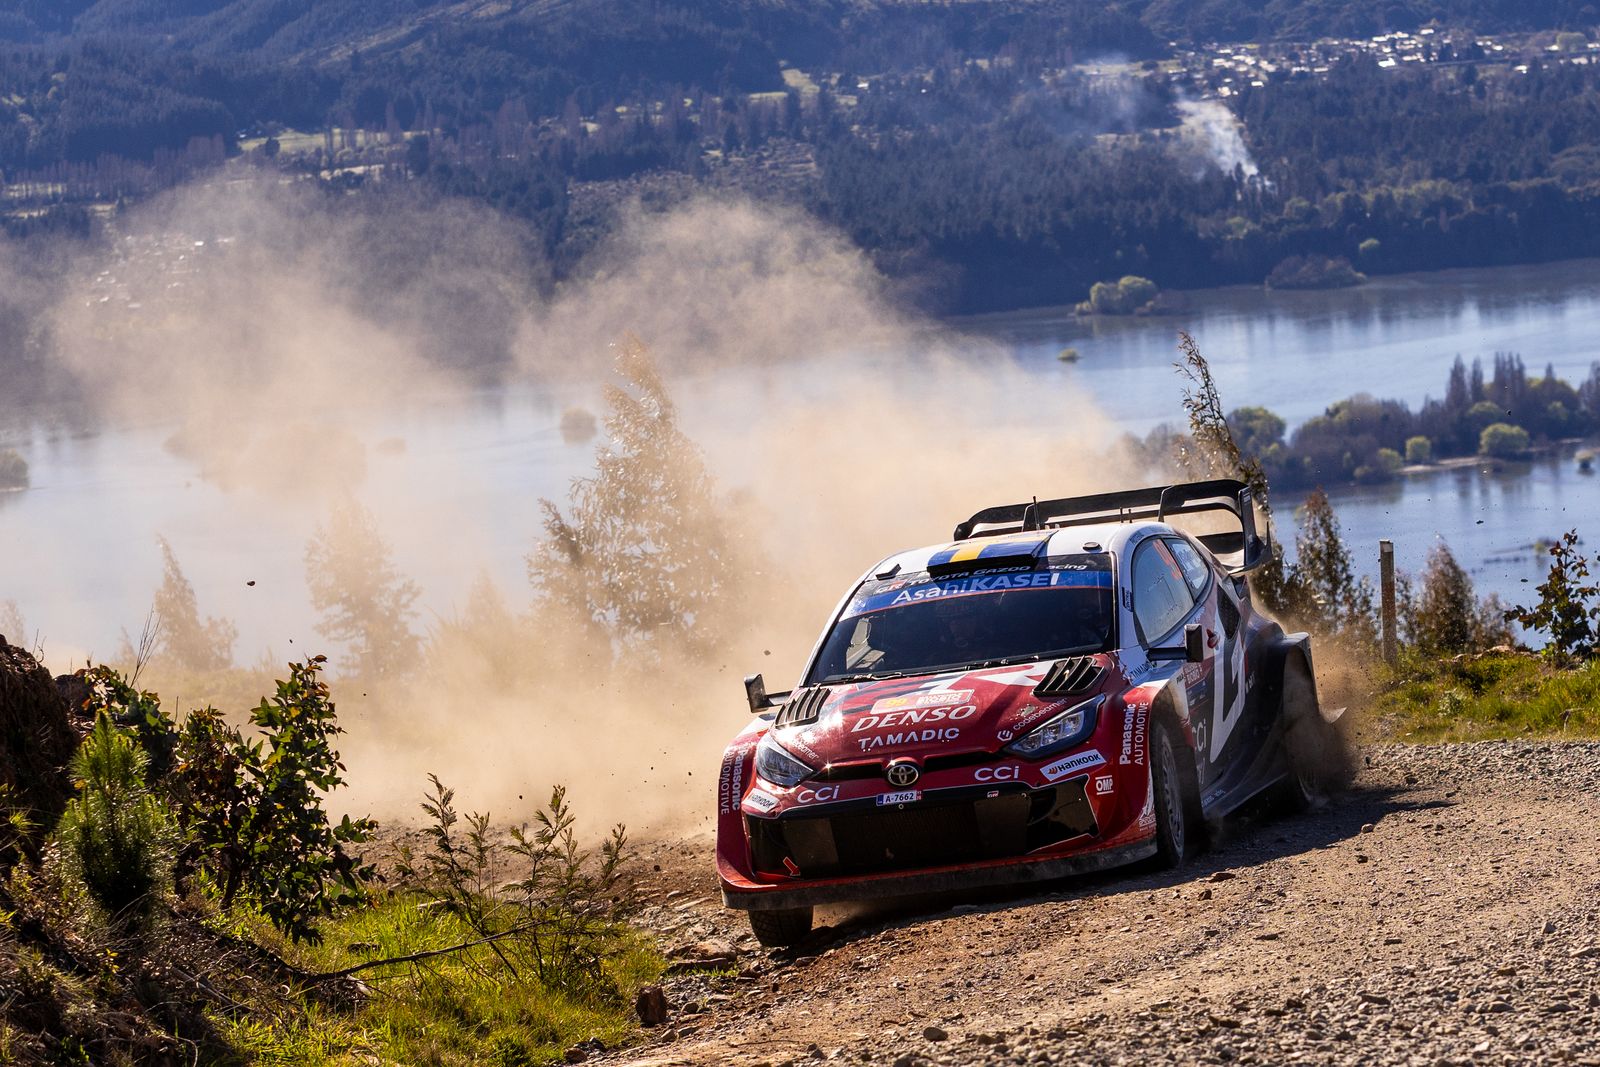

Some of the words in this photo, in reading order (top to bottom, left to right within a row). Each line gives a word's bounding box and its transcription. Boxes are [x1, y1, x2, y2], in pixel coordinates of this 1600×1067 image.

[975, 564, 1031, 576] GAZOO
[1046, 563, 1088, 572] acing
[891, 572, 1060, 605] AsahiKASEI
[851, 705, 976, 733] DENSO
[1013, 697, 1068, 731] codebeamer
[858, 727, 960, 749] TAMADIC
[1119, 703, 1137, 765] Panasonic
[1134, 702, 1149, 765] AUTOMOTIVE
[721, 750, 736, 816] AUTOMOTIVE
[732, 748, 748, 812] Panasonic
[1095, 776, 1114, 791] OMP
[885, 792, 914, 803] A-7662
